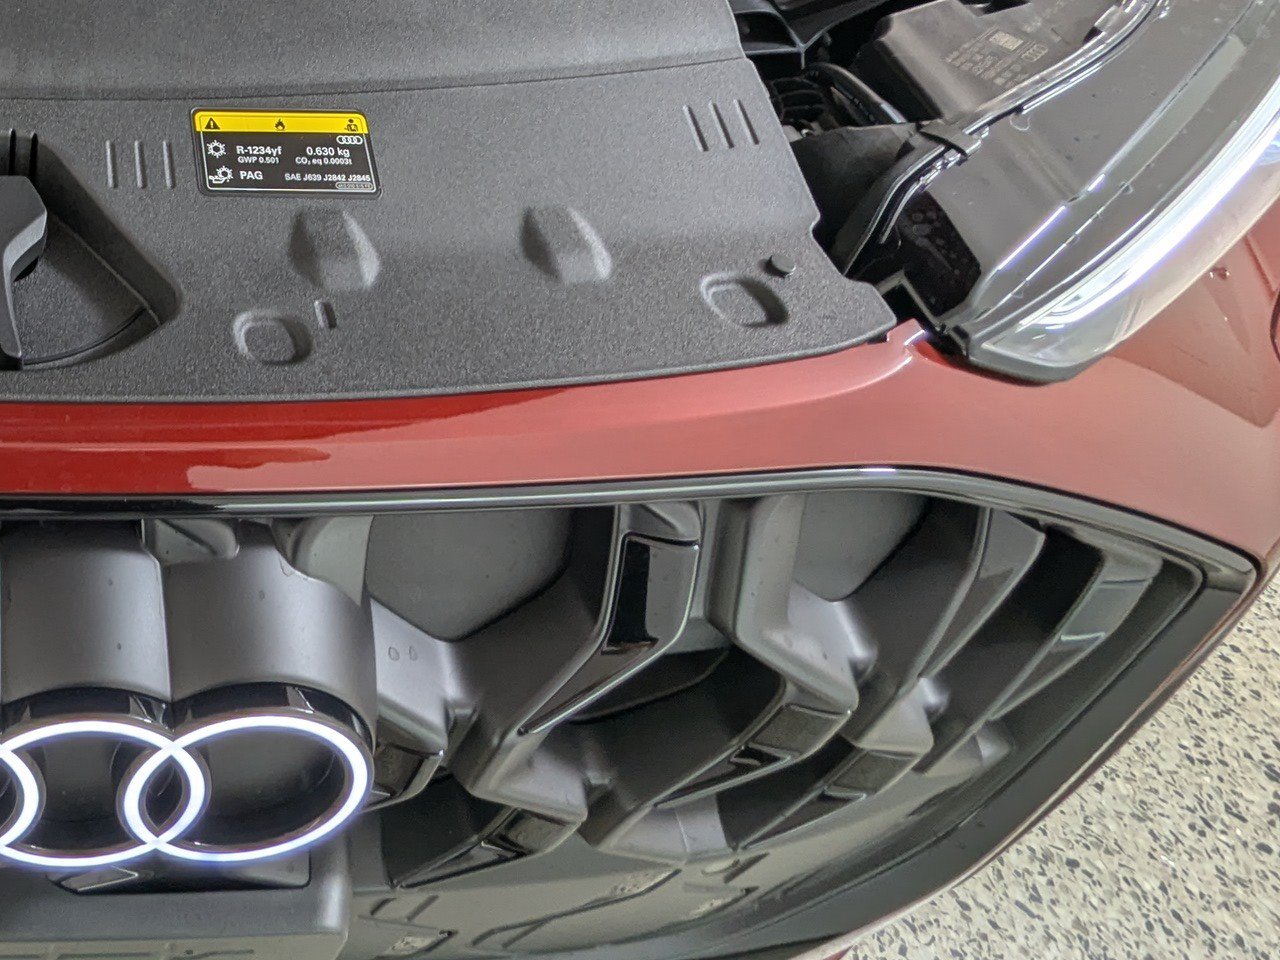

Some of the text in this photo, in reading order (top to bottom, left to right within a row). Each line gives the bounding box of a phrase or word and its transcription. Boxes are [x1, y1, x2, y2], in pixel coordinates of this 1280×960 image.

[236, 145, 282, 156] R-1234yf
[306, 147, 350, 157] 0.630 kg
[258, 156, 279, 164] 0.501
[240, 171, 263, 180] PAG
[284, 173, 370, 182] SAE J639 J2842 J2845
